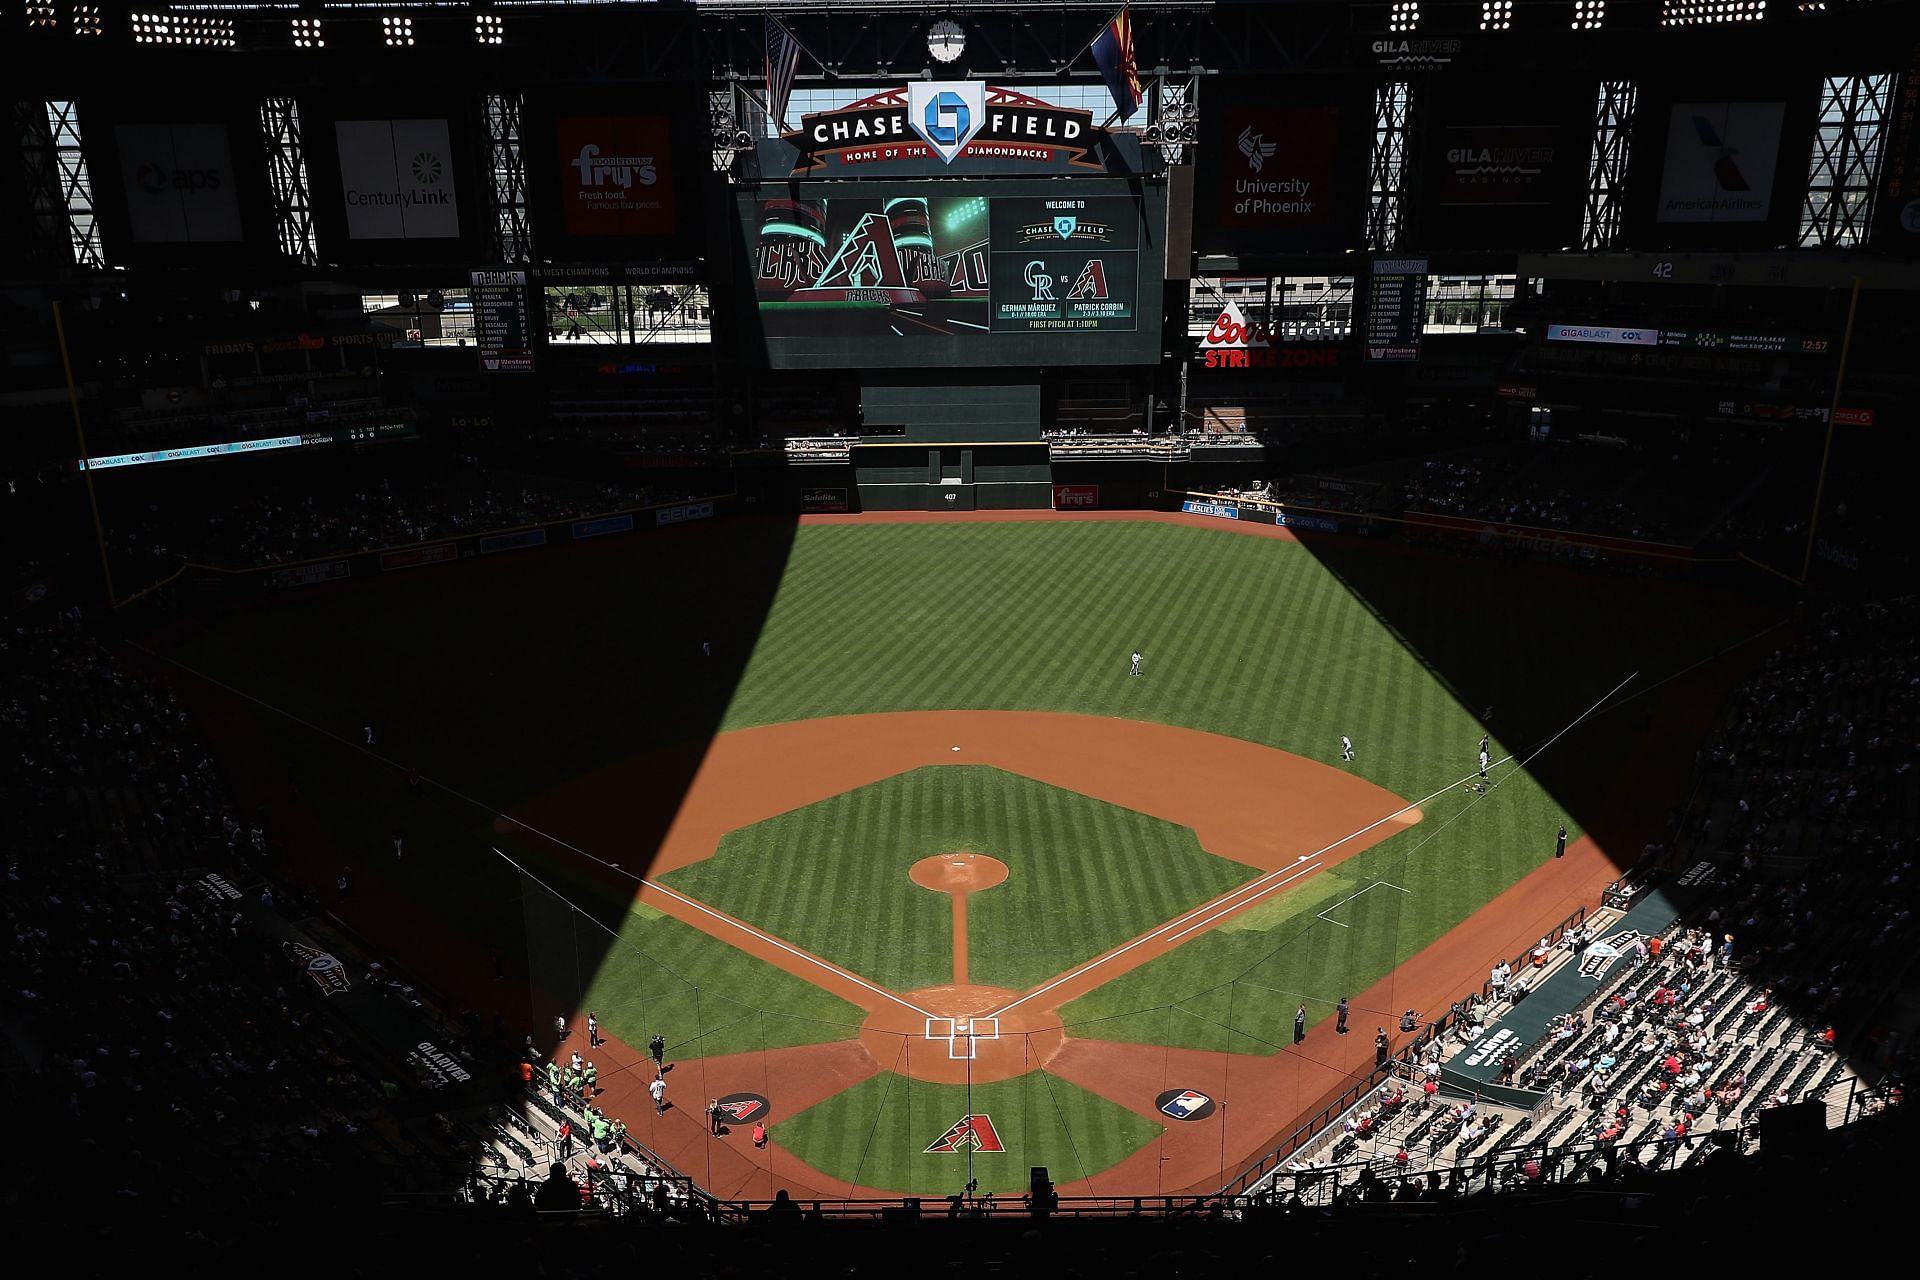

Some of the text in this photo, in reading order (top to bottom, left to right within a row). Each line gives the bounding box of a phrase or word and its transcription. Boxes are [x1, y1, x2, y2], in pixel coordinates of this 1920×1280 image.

[1371, 41, 1410, 53] GILA
[814, 114, 1080, 142] CHASE FIELD
[847, 147, 1048, 162] HOME OF THE DIAMONDBACKS
[1447, 148, 1554, 163] GILA RIVER
[570, 144, 657, 189] fry's
[171, 167, 220, 191] aps
[1235, 178, 1310, 197] University
[347, 190, 448, 208] CenturyLink
[587, 200, 619, 209] Famous
[620, 200, 634, 209] low
[1045, 201, 1075, 209] WELCOME
[1234, 198, 1312, 214] of Phoenix
[1666, 199, 1763, 210] American Airlines
[1025, 226, 1104, 234] CHASE FIELD
[543, 268, 564, 276] WEST
[566, 267, 609, 276] CHAMPIONS
[624, 265, 694, 275] WORLD CHAMPIONS
[1652, 262, 1673, 279] 42
[1060, 275, 1068, 283] VS
[1027, 302, 1056, 311] MÁRQUEZ
[1074, 303, 1100, 311] PATRICK
[1076, 320, 1098, 328] 1:10PM
[1560, 329, 1641, 340] GIGABLAST COX
[205, 343, 255, 355] FRIDAYS
[331, 334, 373, 346] SPORTS
[1801, 340, 1828, 350] 12:57
[1205, 349, 1340, 368] STRIKE ZONE
[90, 457, 124, 467] GIGABLAST
[167, 449, 200, 458] GIGABLAST
[241, 441, 272, 450] GIGABLAST
[1056, 487, 1094, 505] fry's
[1815, 537, 1859, 570] StubHub
[1464, 1028, 1515, 1066] GILA RIVER
[417, 1042, 444, 1061] GILA
[436, 1057, 471, 1082] RIVER
